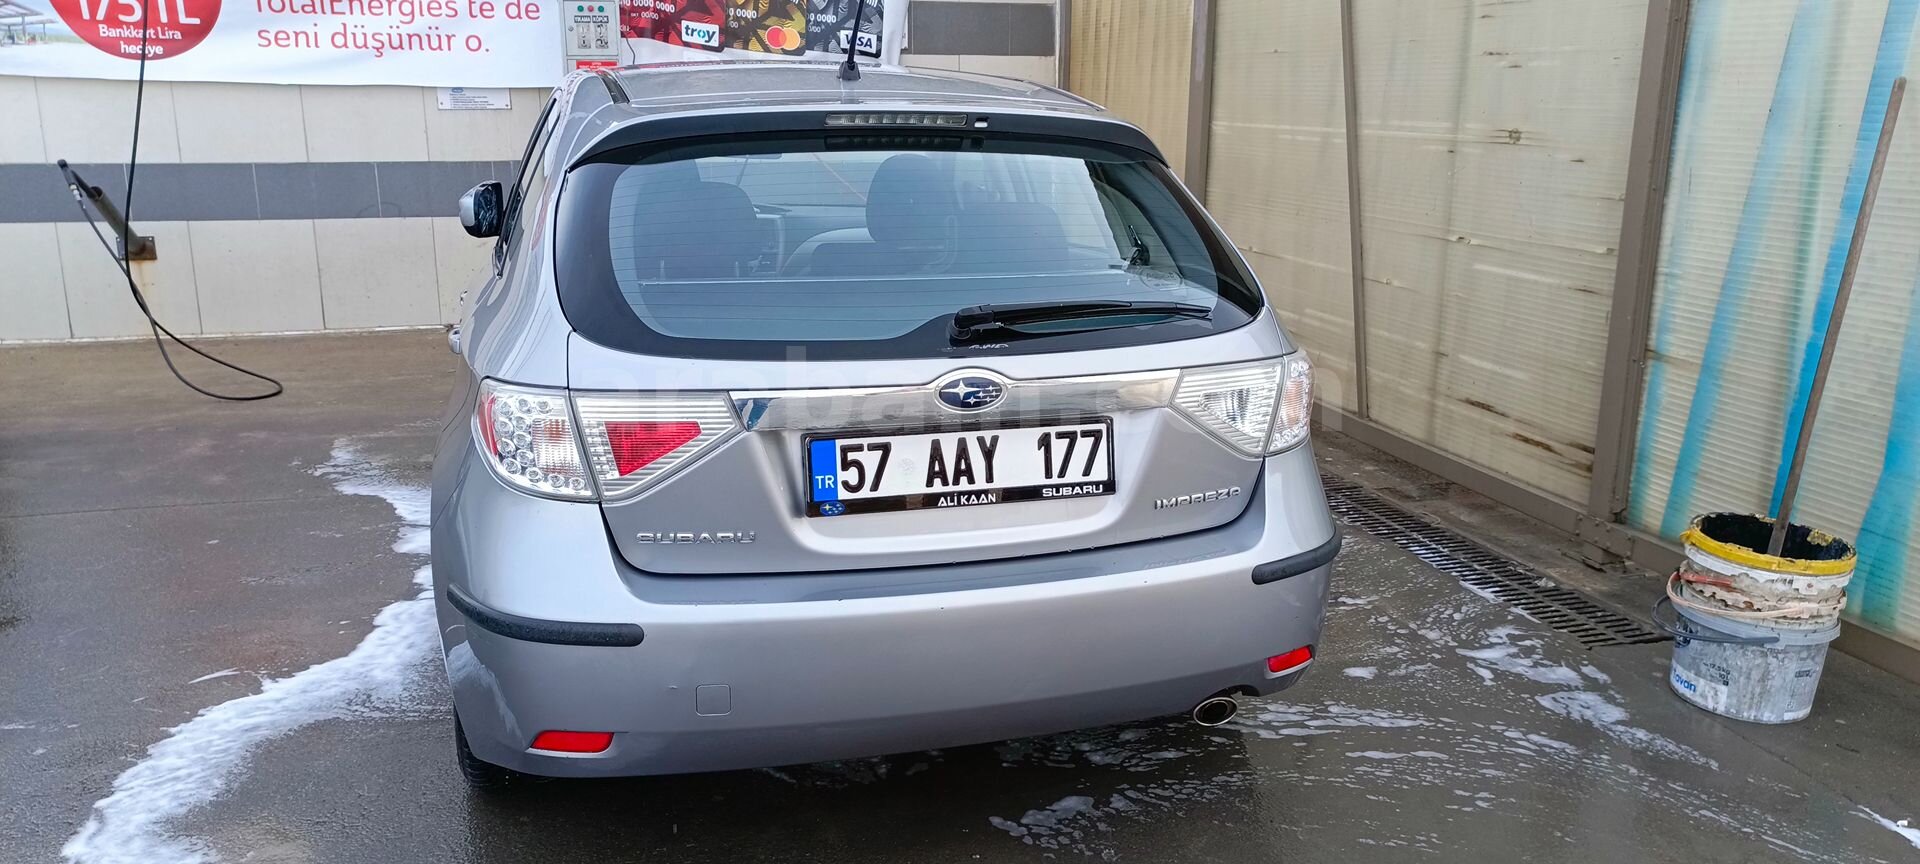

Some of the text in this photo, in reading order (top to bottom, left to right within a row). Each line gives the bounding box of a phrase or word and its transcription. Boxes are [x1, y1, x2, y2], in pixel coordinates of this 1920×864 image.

[256, 0, 458, 25] TotalEnergies
[504, 0, 541, 20] de
[736, 8, 757, 19] 0000
[816, 13, 837, 23] 0000
[157, 27, 182, 40] Lira
[257, 22, 490, 58] seni düşünür o.
[684, 24, 716, 43] troy
[844, 33, 873, 49] VSA
[840, 428, 1103, 493] 57 AAY 177
[815, 474, 835, 490] TR
[960, 492, 997, 505] KAAN
[1042, 484, 1103, 497] SUBARU
[1154, 486, 1241, 510] IMPREZA
[636, 532, 755, 544] SUBARU
